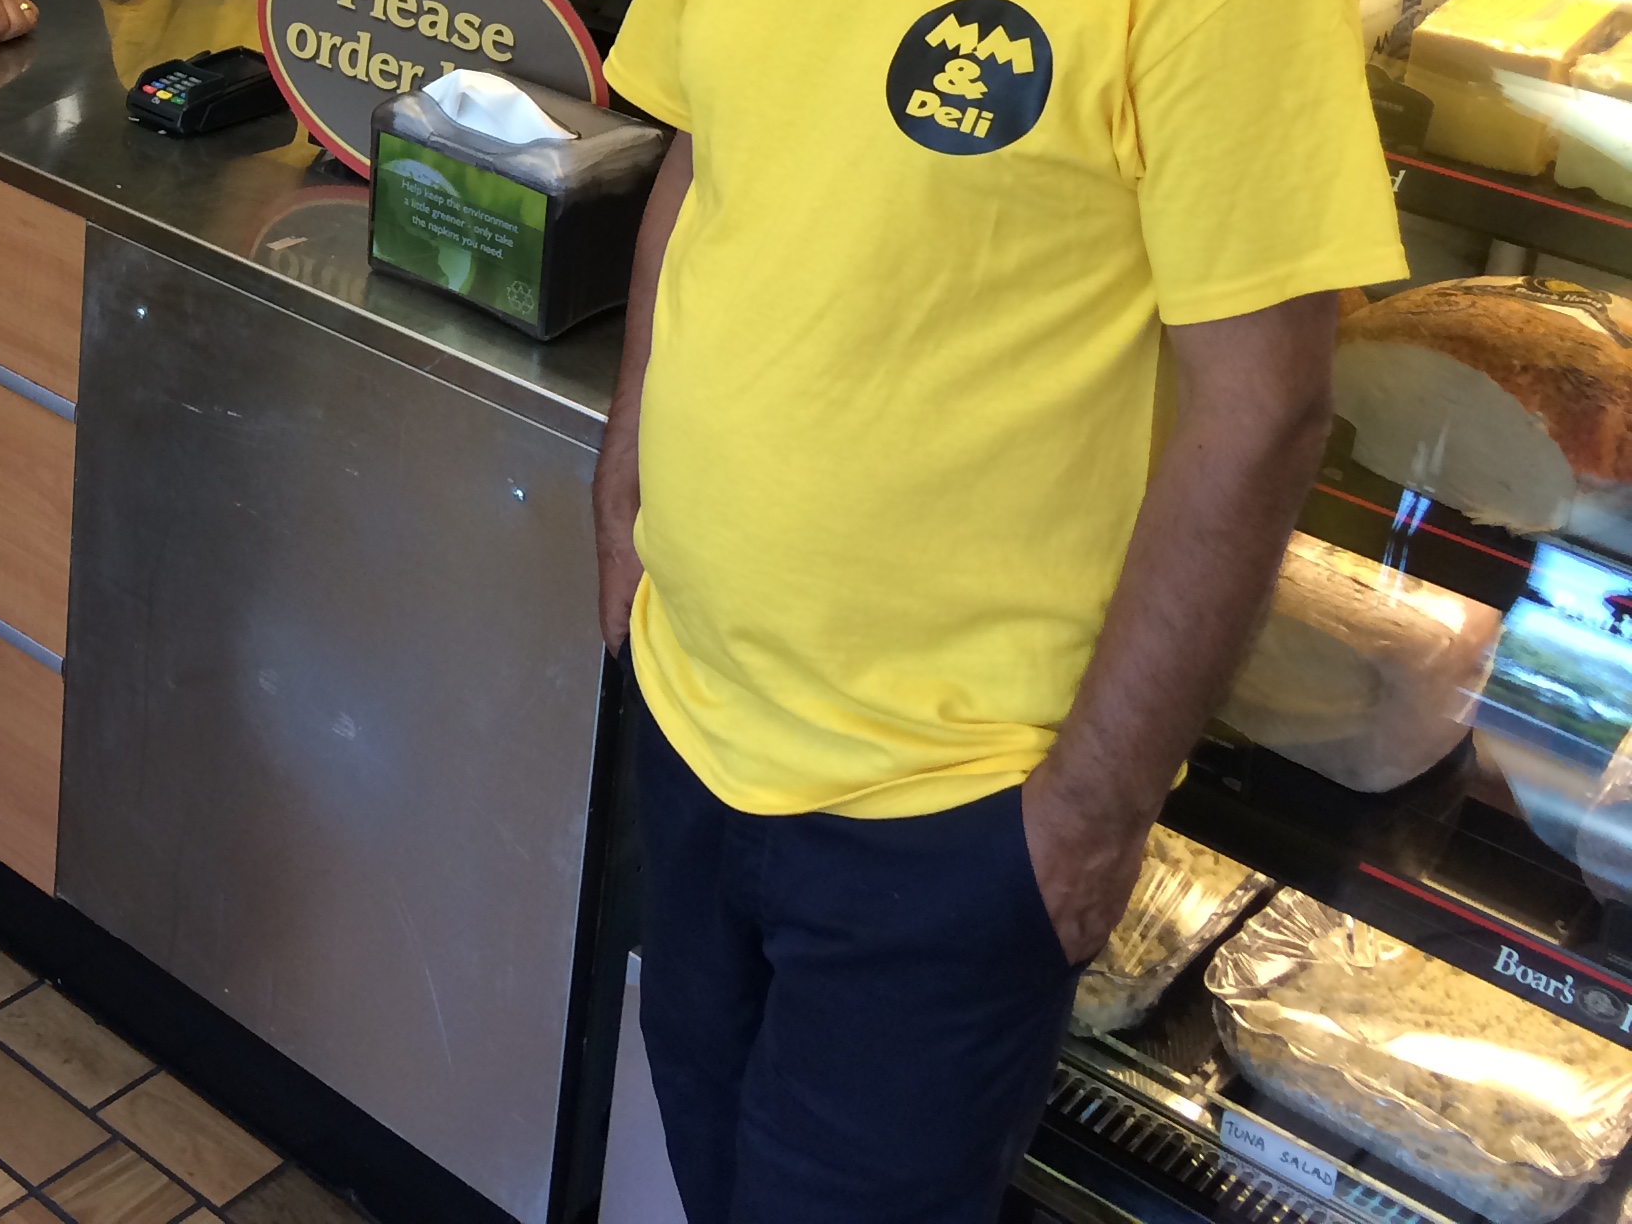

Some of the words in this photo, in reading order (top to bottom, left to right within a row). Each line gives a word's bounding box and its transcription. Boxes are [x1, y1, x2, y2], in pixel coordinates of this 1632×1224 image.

[286, 21, 424, 94] order
[924, 12, 1035, 74] MM
[933, 58, 989, 100] &
[905, 89, 995, 139] Deli
[402, 179, 422, 196] Help
[424, 188, 444, 205] keep
[447, 197, 461, 211] the
[463, 206, 519, 234] environment
[411, 198, 430, 214] little
[431, 209, 465, 228] greener
[474, 226, 493, 241] only
[495, 233, 513, 247] take
[412, 215, 426, 228] the
[428, 222, 459, 242] napkins
[461, 236, 478, 249] you
[480, 243, 504, 259] need.
[1493, 944, 1575, 1005] Boar's
[1225, 1120, 1266, 1151] TUNA
[1279, 1151, 1333, 1186] SALAD
